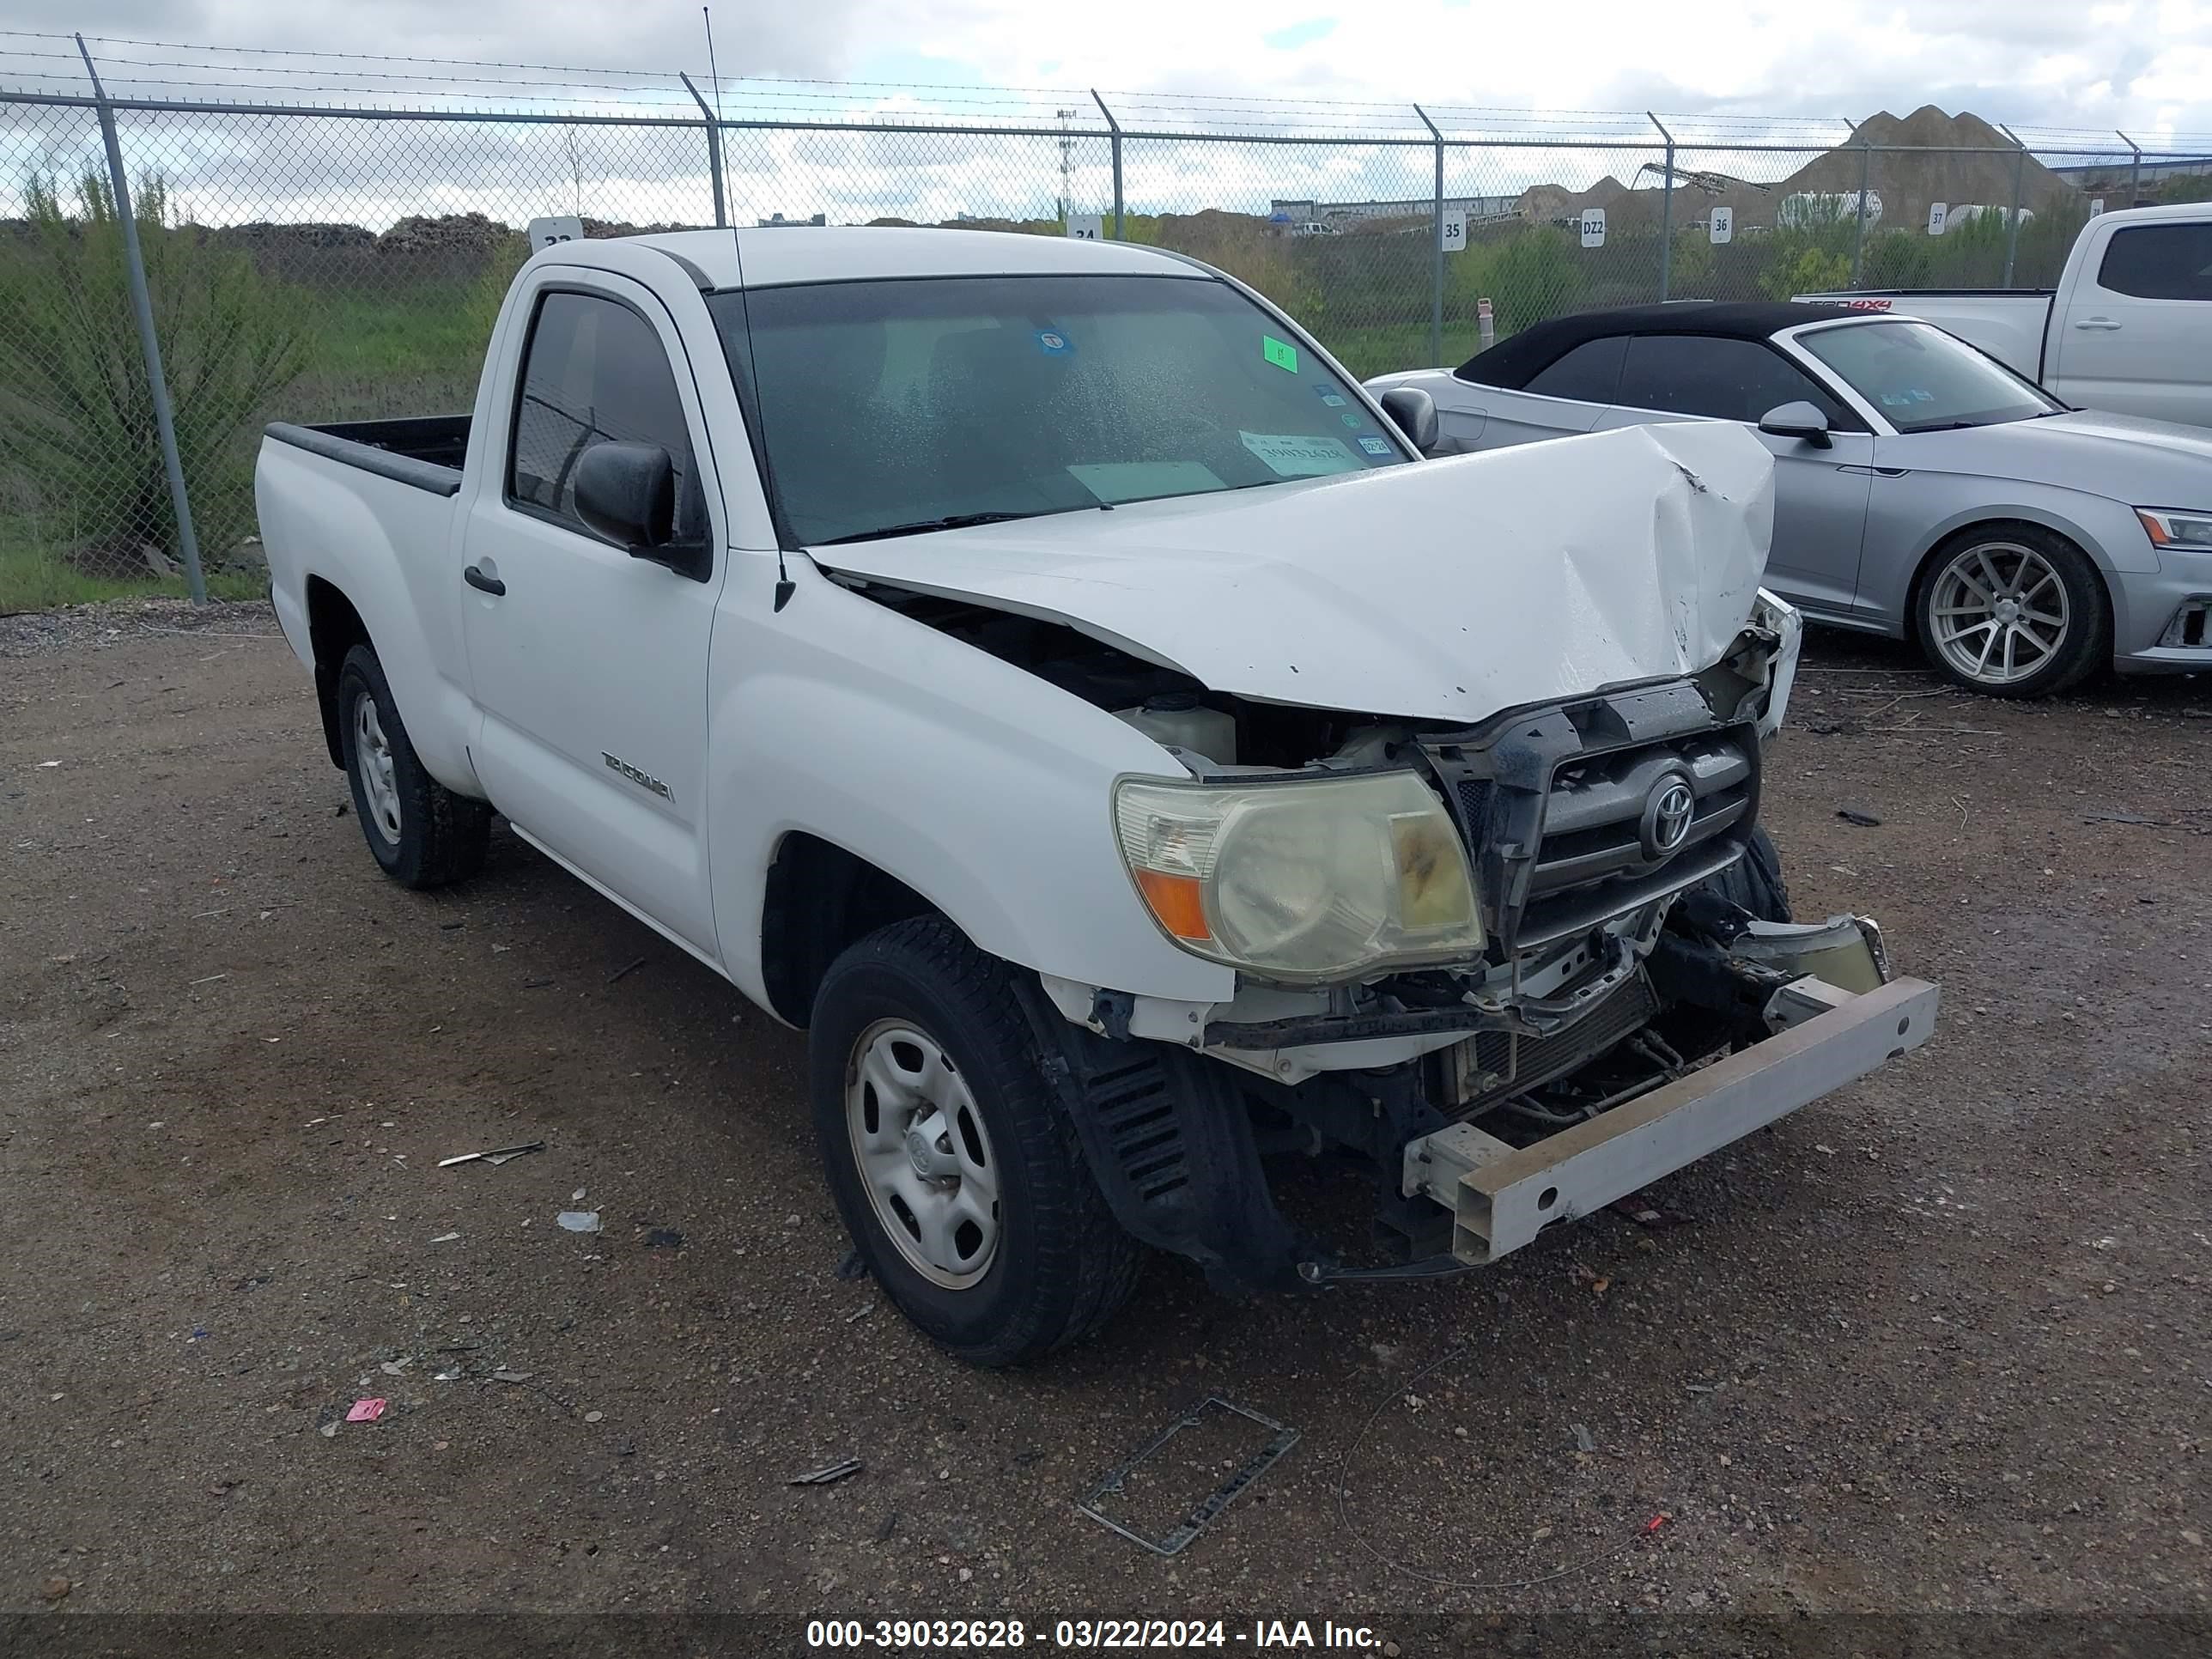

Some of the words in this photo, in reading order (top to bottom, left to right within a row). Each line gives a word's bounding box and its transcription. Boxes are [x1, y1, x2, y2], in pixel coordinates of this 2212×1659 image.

[1715, 218, 1728, 232] 36
[1932, 212, 1942, 224] 37
[1445, 223, 1460, 238] 35
[1583, 220, 1604, 234] DZ2
